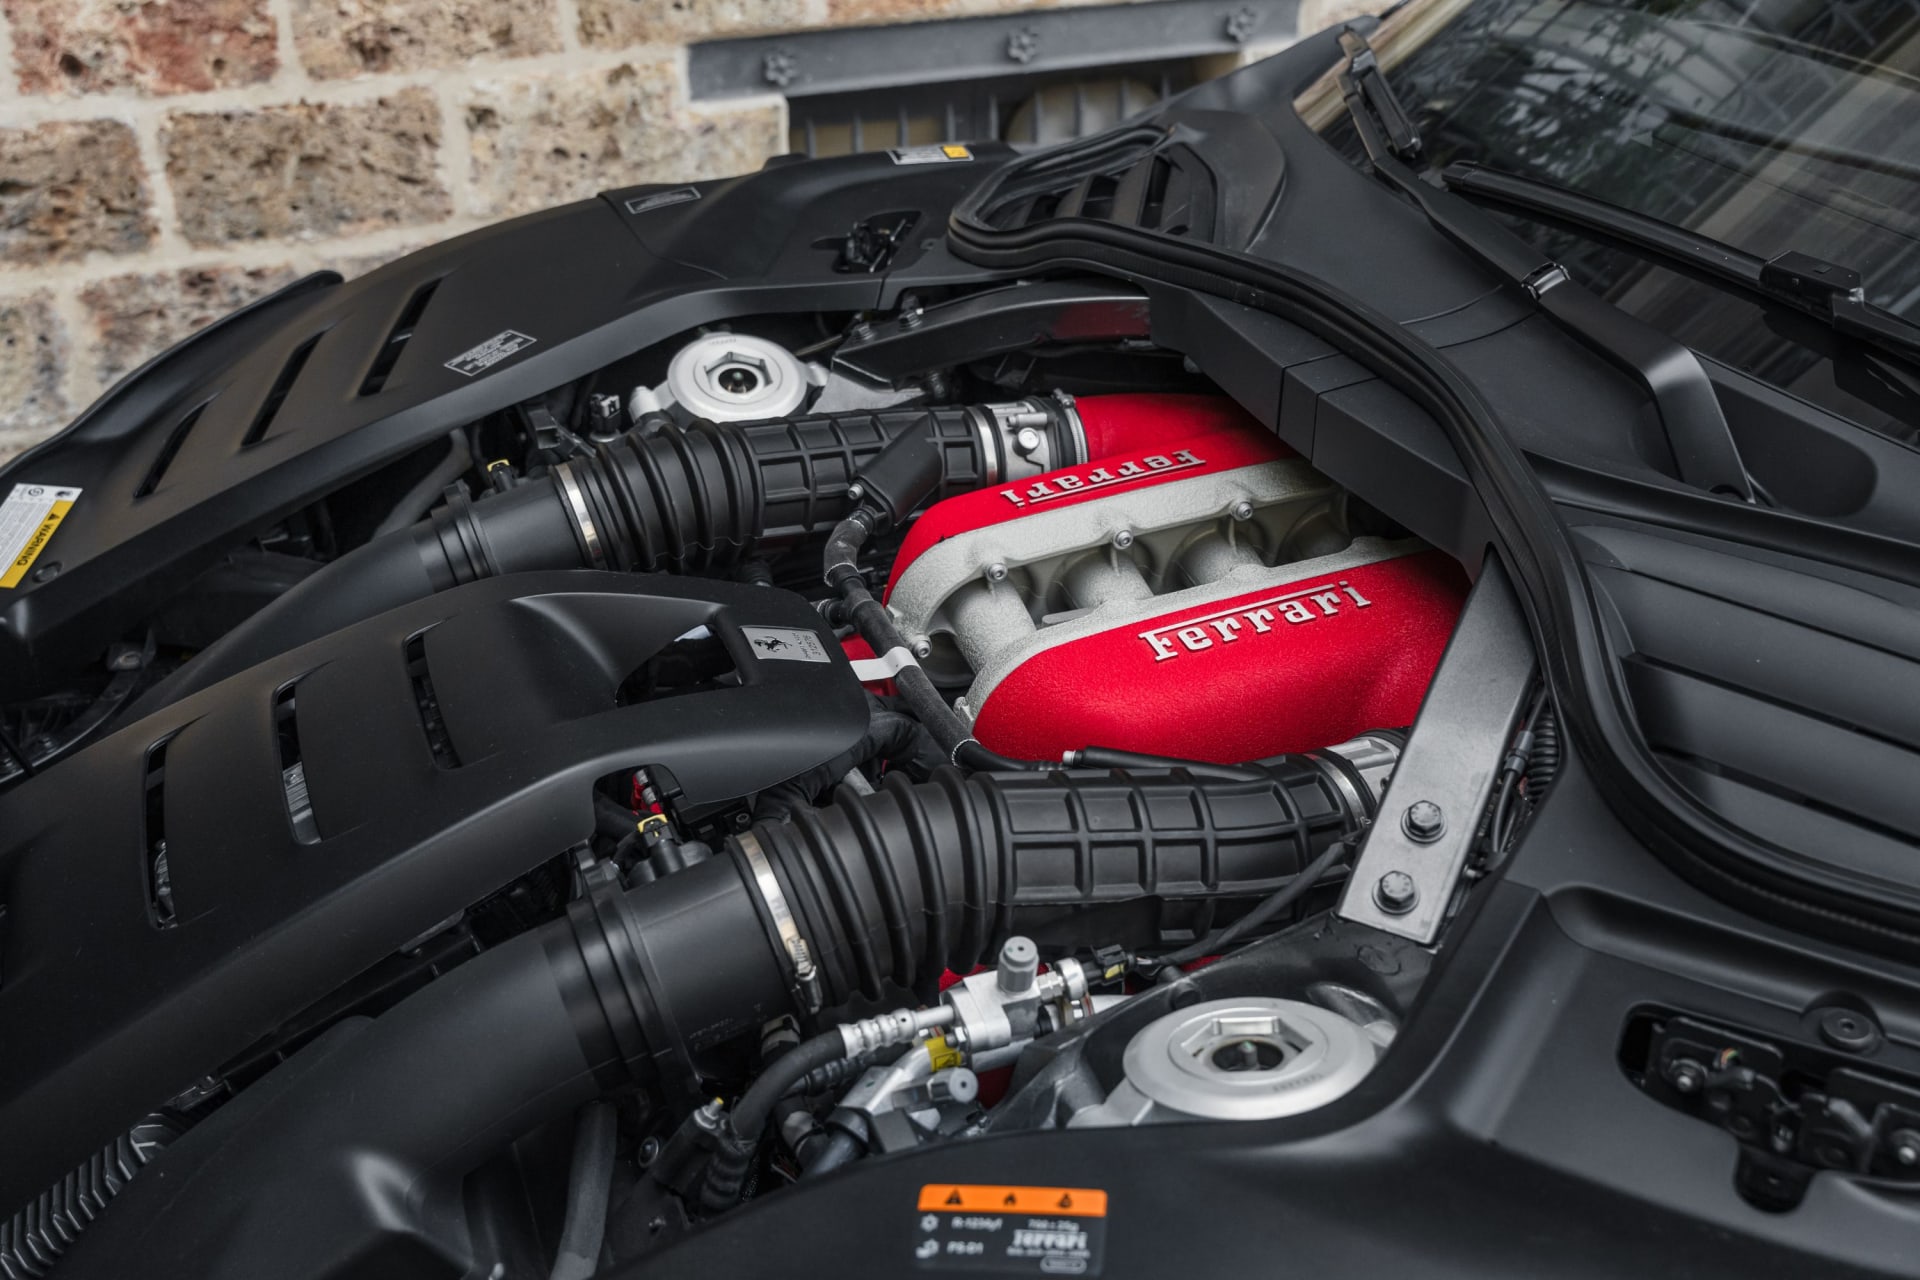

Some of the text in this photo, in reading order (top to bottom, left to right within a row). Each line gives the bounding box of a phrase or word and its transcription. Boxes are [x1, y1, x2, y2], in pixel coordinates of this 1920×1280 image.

[1001, 449, 1207, 507] Ferrari
[17, 523, 52, 566] WARNING
[1138, 581, 1372, 661] Ferrari
